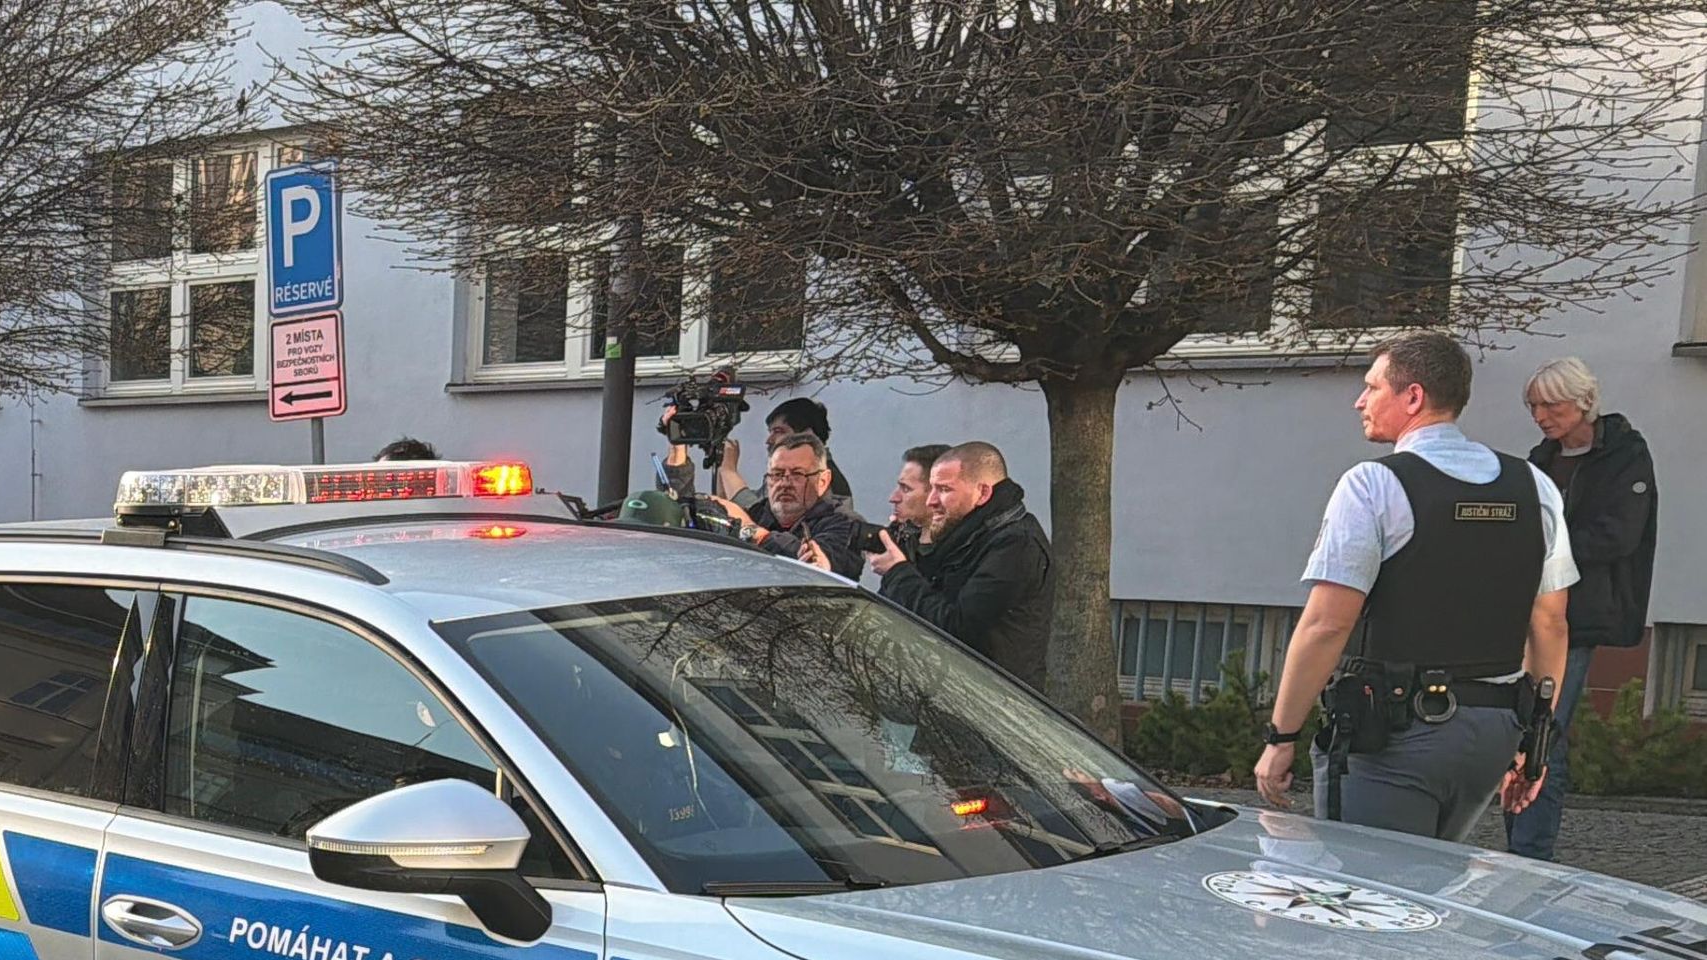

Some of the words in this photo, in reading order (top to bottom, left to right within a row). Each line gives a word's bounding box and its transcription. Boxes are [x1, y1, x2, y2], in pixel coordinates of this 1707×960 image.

[282, 185, 321, 268] P
[275, 275, 332, 302] RÉSERVÉ
[286, 333, 292, 345] 2
[293, 329, 324, 344] MÍSTA
[287, 346, 303, 357] PRO
[304, 344, 323, 354] VOZY
